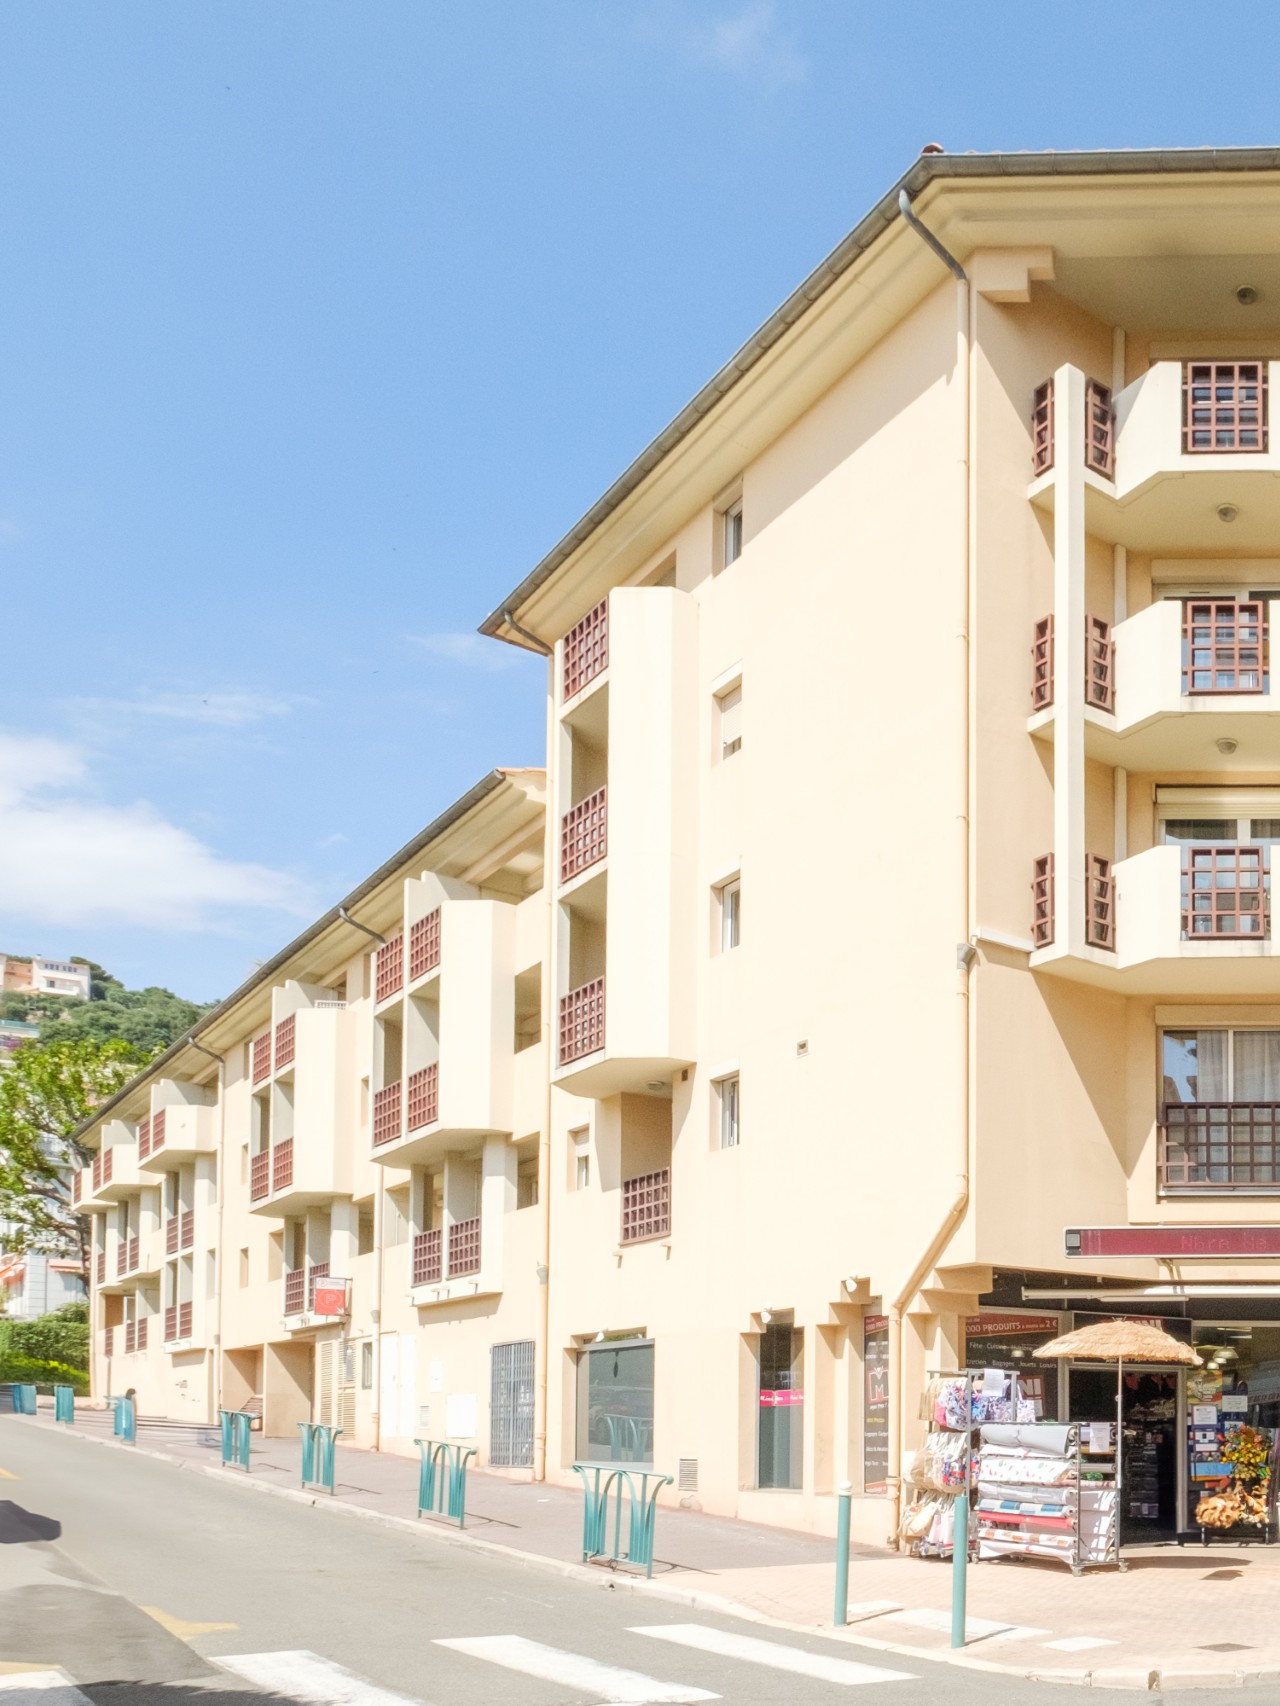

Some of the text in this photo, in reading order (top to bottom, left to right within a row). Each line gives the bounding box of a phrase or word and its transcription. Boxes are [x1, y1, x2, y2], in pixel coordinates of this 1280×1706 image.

[966, 1324, 981, 1333] 000
[982, 1322, 1021, 1332] PRODUITS
[1045, 1320, 1051, 1328] 2
[969, 1342, 983, 1350] Fête
